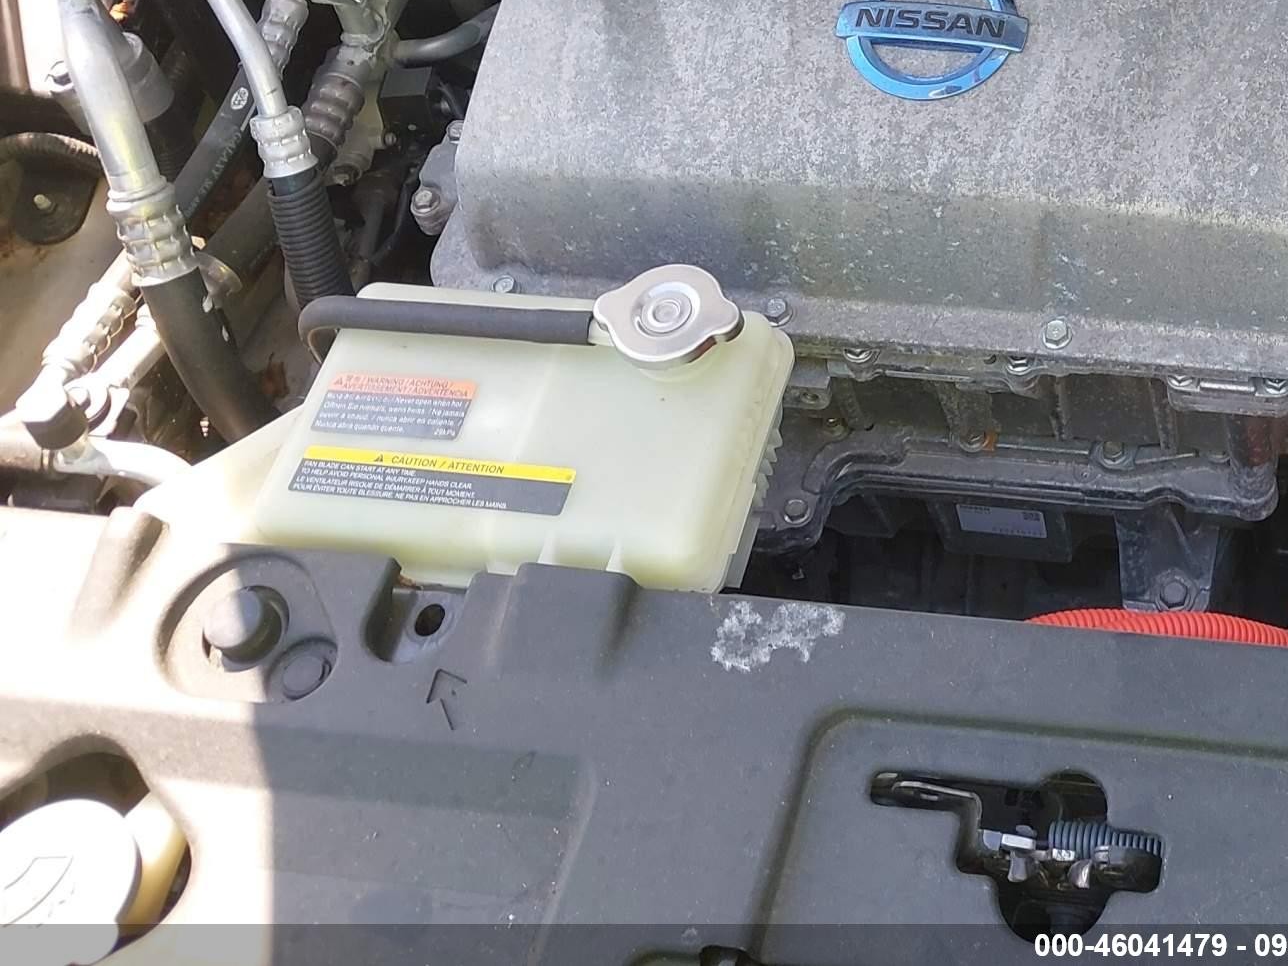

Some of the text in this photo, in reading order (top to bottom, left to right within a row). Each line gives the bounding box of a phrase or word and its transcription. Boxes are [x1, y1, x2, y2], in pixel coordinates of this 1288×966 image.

[855, 8, 1005, 38] NISSAN
[318, 462, 339, 470] BLADE
[355, 465, 376, 473] START
[385, 467, 400, 475] ANY
[392, 456, 437, 467] CAUTION
[448, 462, 504, 474] ATTENTION
[296, 475, 305, 483] LE
[306, 476, 348, 486] VENTILATEUR
[348, 480, 373, 489] RISQUE
[428, 488, 445, 496] TOUT
[301, 467, 310, 475] TO
[328, 470, 349, 478] AVOID
[349, 472, 384, 481] PERSONAL
[426, 479, 449, 488] HANDS
[293, 483, 313, 491] POUR
[336, 487, 356, 495] TOUTE
[394, 491, 405, 499] NE
[405, 493, 419, 501] PAS
[419, 494, 429, 502] EN
[430, 495, 471, 507] APPROCHER
[471, 499, 484, 507] LES
